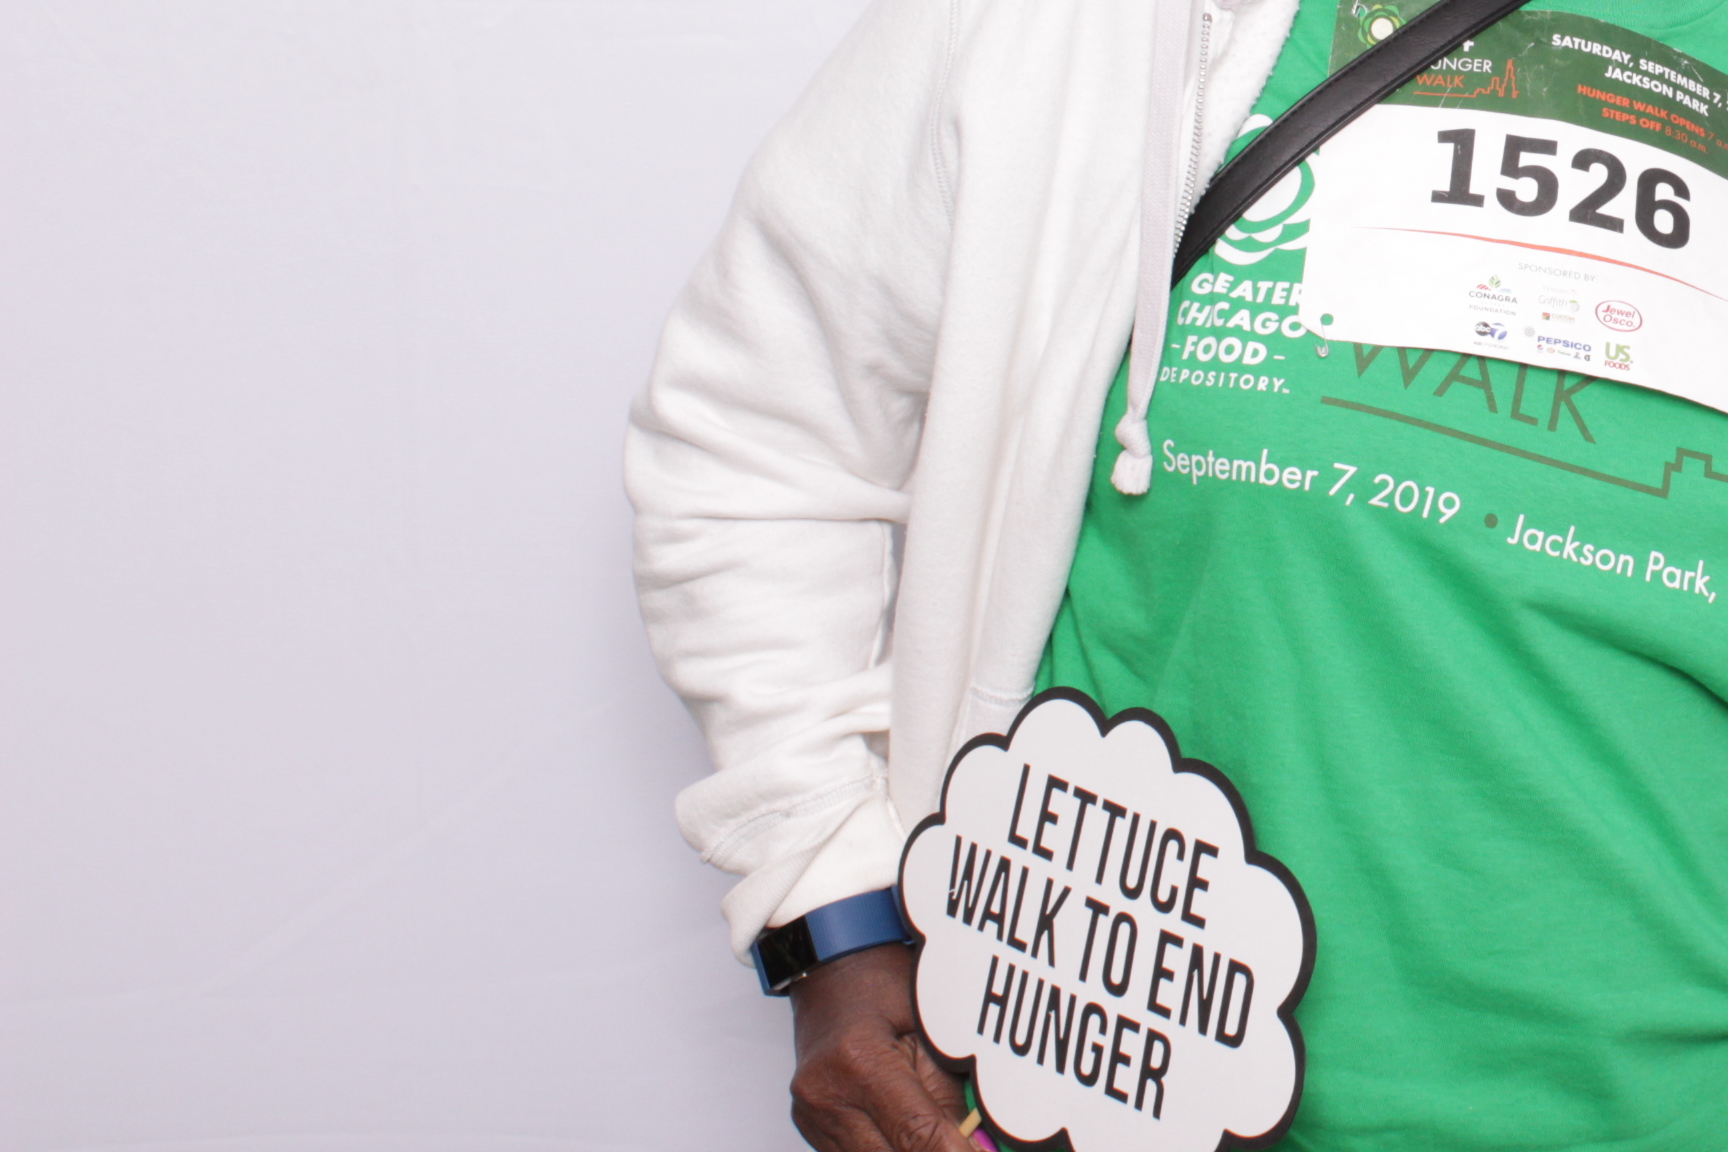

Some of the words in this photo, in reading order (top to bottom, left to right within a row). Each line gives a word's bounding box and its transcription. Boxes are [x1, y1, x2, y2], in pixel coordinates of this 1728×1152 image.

[1416, 73, 1466, 88] WALK
[1430, 56, 1493, 74] UNGER
[1551, 33, 1634, 68] SATURDAY,
[1639, 58, 1710, 100] SEPTEMBER
[1712, 92, 1723, 108] 7,
[1604, 65, 1673, 98] JACKSON
[1676, 89, 1709, 117] PARK
[1577, 84, 1630, 108] HUNGER
[1632, 99, 1669, 120] WALK
[1670, 113, 1707, 138] OPENS
[1601, 107, 1637, 126] STEPS
[1639, 117, 1663, 133] OFF
[1664, 125, 1689, 144] 8:30
[1430, 127, 1691, 250] 1526
[1518, 261, 1581, 280] SPONSORED
[1468, 290, 1518, 305] CONAGRA
[1468, 304, 1517, 317] FOUNDATION
[1538, 294, 1568, 308] Griffith
[1602, 304, 1636, 319] Jewel
[1176, 299, 1309, 339] CHICAGO
[1537, 335, 1592, 352] PEPSICO
[1604, 360, 1631, 371] FOODS
[1354, 343, 1600, 445] WALK
[1162, 438, 1319, 485] September
[1328, 462, 1358, 506] 7,
[1367, 473, 1461, 524] 2019
[1506, 513, 1635, 578] Jackson
[1645, 550, 1717, 604] Park,
[1007, 762, 1219, 930] LETTUCE
[945, 833, 1072, 969] WALK
[1077, 895, 1138, 999] TO
[1146, 928, 1255, 1049] END
[976, 953, 1172, 1121] HUNGER
